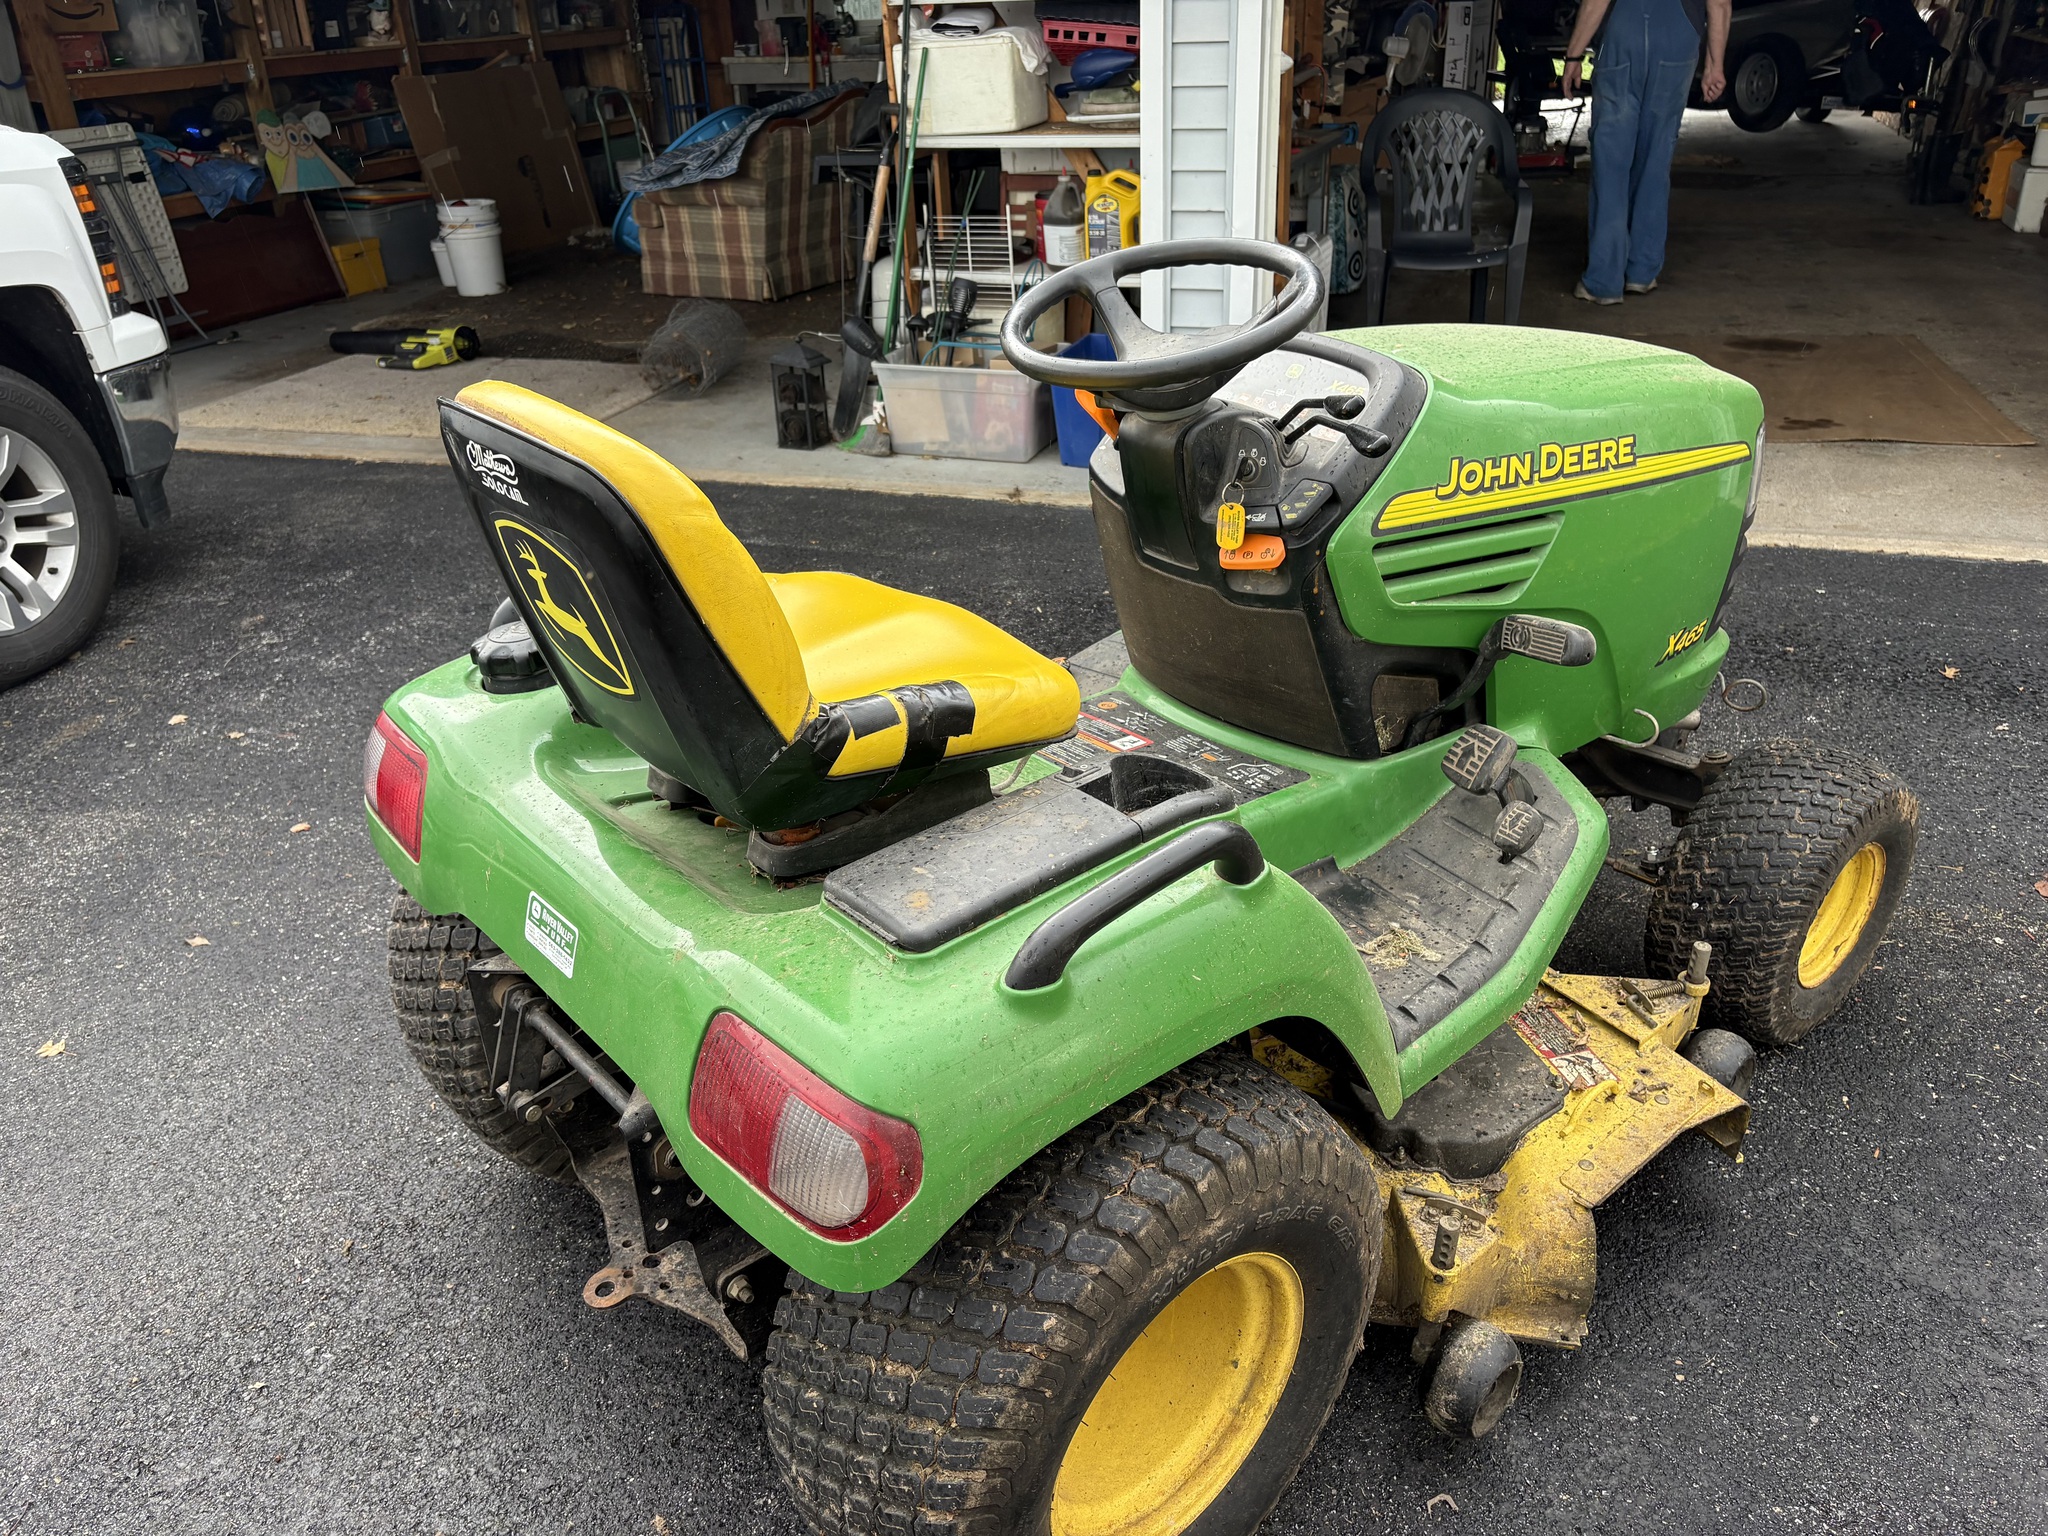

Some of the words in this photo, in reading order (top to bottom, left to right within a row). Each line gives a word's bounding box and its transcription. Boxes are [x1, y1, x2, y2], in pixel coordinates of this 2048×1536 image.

[1329, 379, 1366, 396] X465
[466, 440, 518, 484] Mathews
[1437, 453, 1532, 497] JOHN
[1540, 435, 1636, 479] DEERE
[481, 473, 529, 506] SOLOCAM
[1656, 618, 1709, 664] X465
[542, 908, 558, 931] RIVER
[557, 920, 574, 944] VALLEY
[546, 925, 566, 949] TURF
[1149, 1224, 1244, 1311] MULTI
[1255, 1205, 1323, 1231] TRAC
